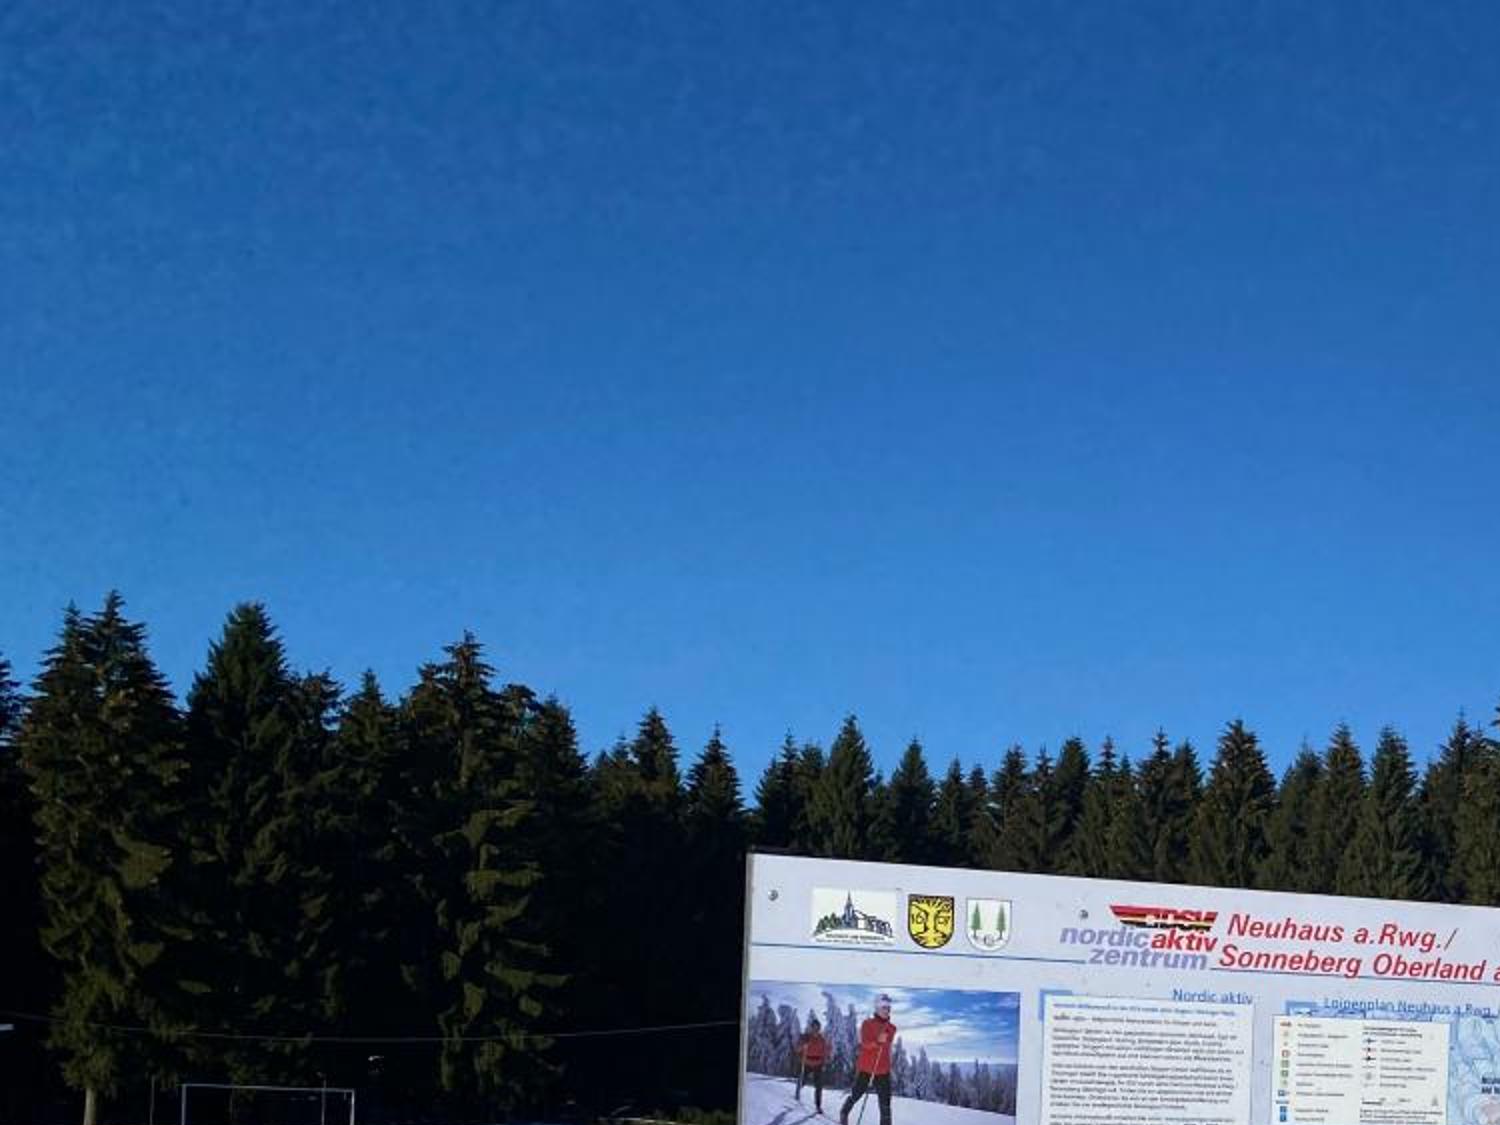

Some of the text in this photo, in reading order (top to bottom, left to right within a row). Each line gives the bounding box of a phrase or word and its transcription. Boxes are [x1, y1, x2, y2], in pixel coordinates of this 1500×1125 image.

[1227, 913, 1345, 943] Neuhaus
[1089, 947, 1208, 970] zentrum
[1219, 943, 1363, 979] Sonneberg
[1373, 953, 1487, 982] Oberland
[1172, 988, 1254, 1005] Nordic aktiv
[1323, 998, 1395, 1014] Loipenplan
[1399, 1000, 1450, 1015] Neuhaus
